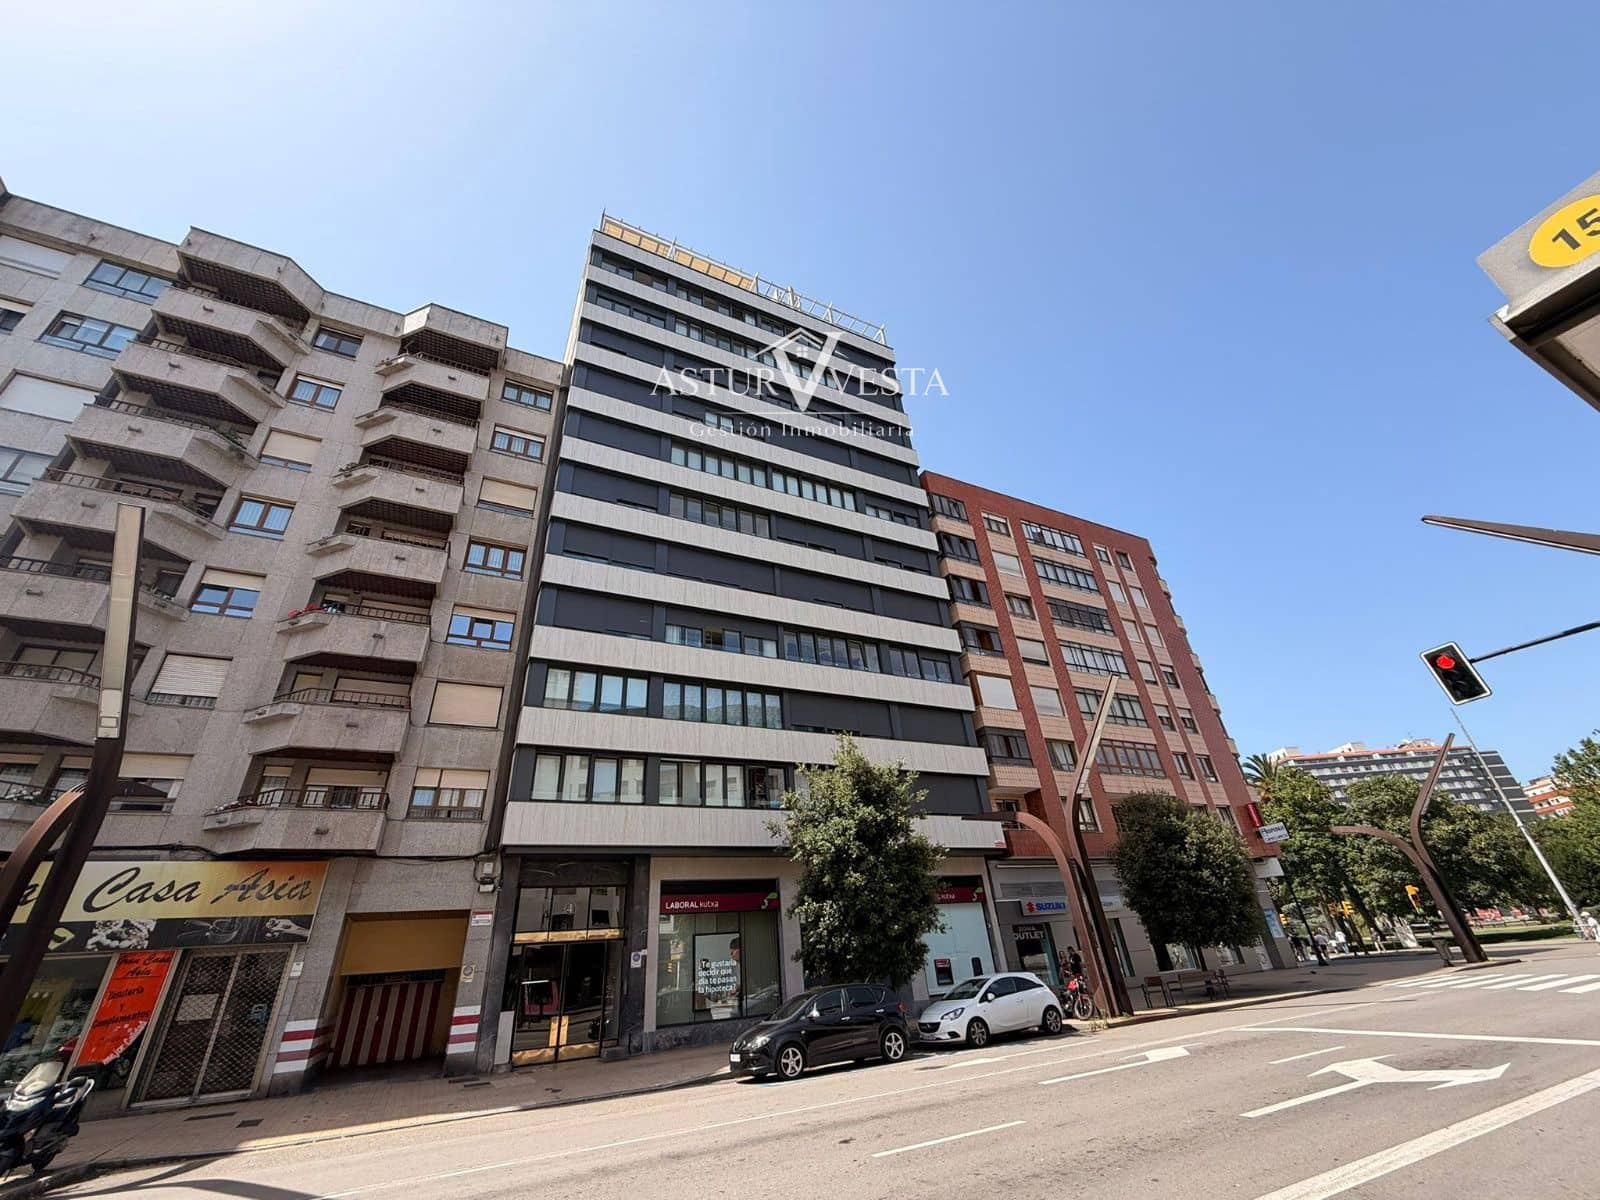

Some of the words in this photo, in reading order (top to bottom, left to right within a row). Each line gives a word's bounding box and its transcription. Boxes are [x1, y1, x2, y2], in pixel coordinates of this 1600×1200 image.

[82, 866, 202, 913] Casa
[211, 867, 312, 905] Asia
[665, 901, 699, 910] LABORAL
[700, 900, 719, 908] kutxa
[1036, 901, 1066, 911] SUZUKI
[1014, 931, 1045, 941] OUTLET
